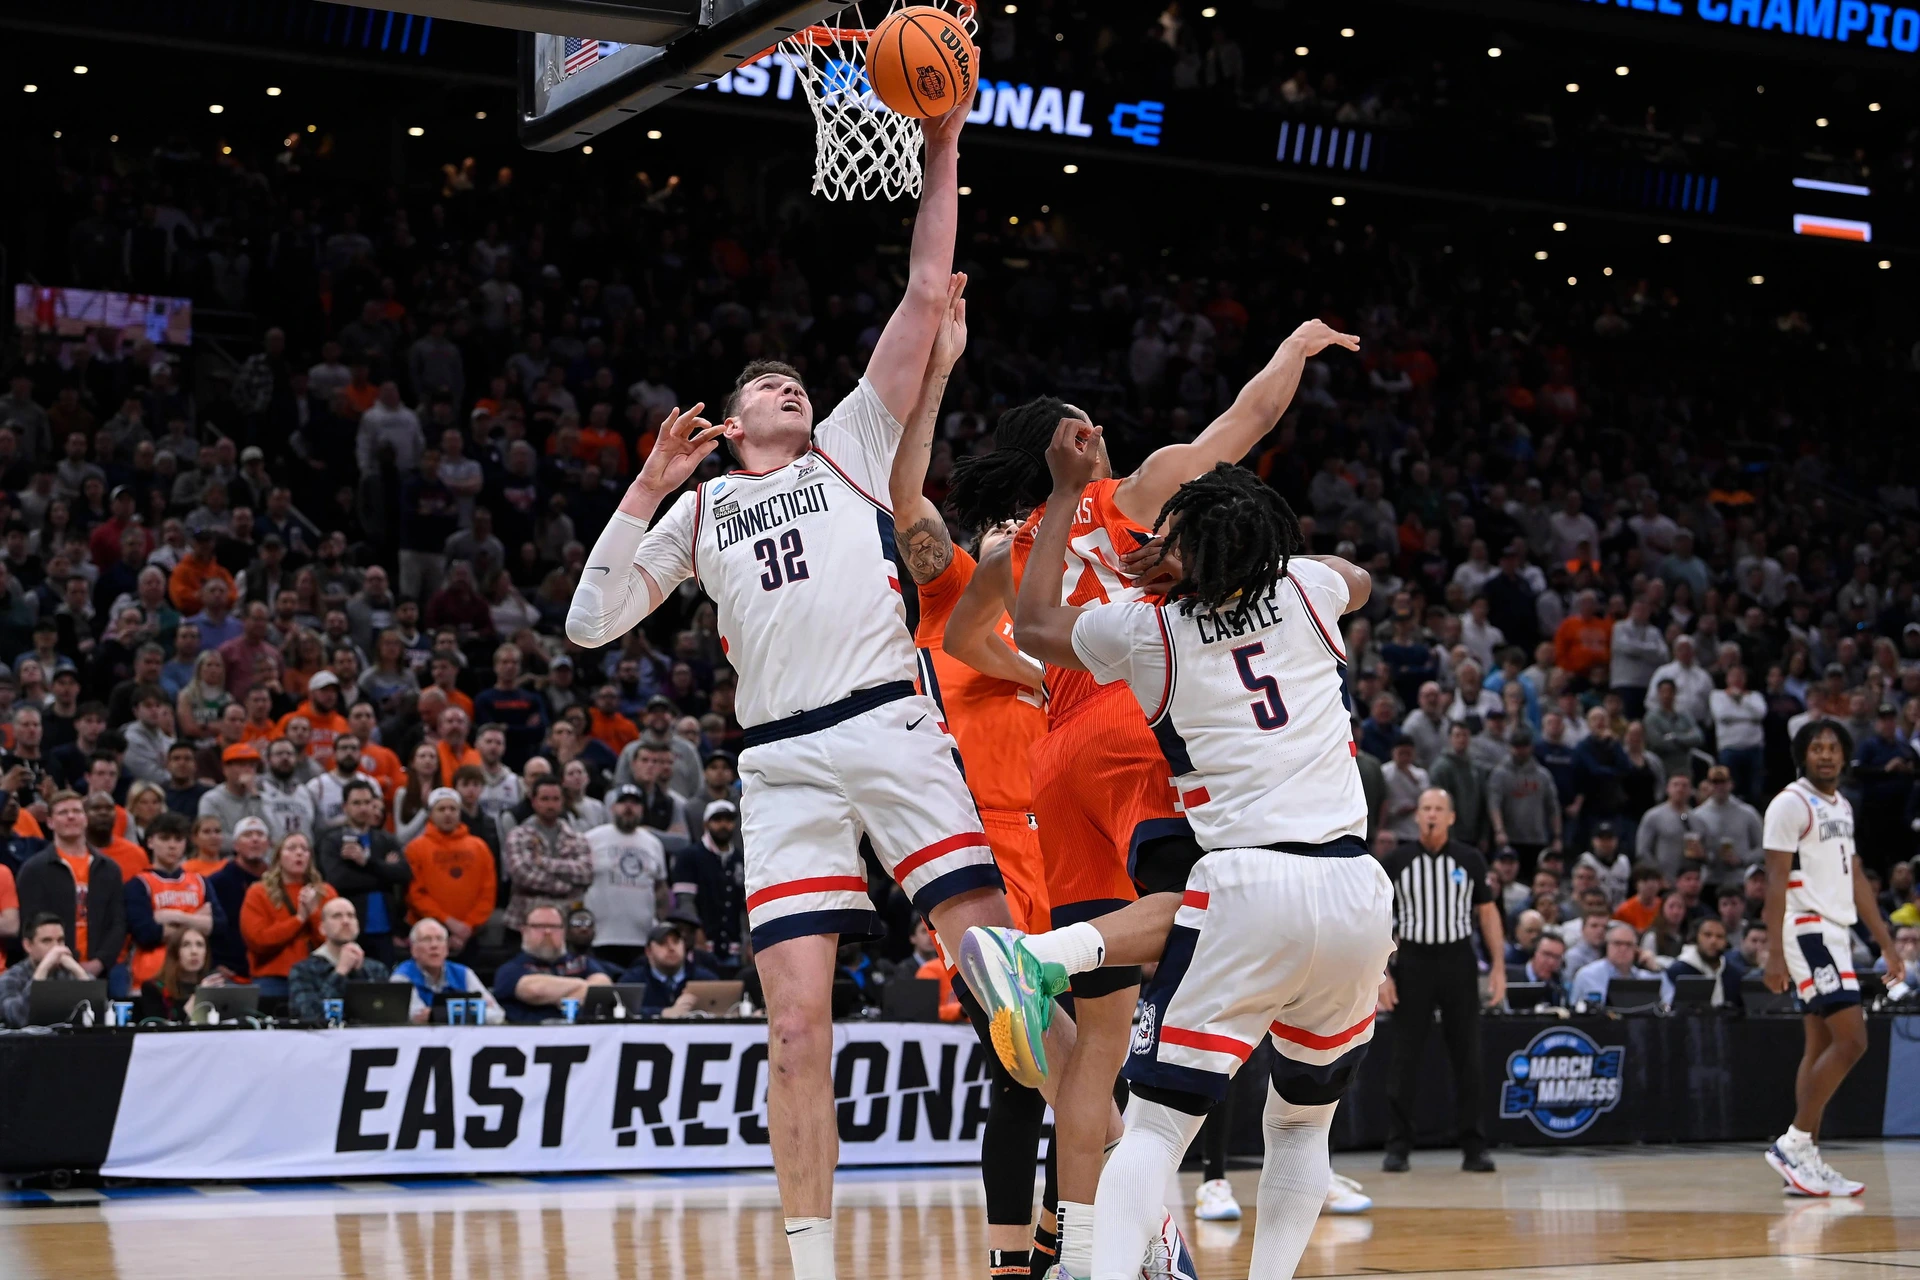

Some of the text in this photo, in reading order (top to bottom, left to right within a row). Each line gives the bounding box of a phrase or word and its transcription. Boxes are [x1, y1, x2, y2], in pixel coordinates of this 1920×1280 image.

[940, 26, 970, 97] Wilson
[715, 483, 829, 552] CONNECTICUT
[753, 528, 810, 592] 32
[1196, 597, 1283, 644] CASTLE
[1230, 641, 1289, 731] 5
[335, 1045, 590, 1153] EAST
[1528, 1055, 1593, 1080] MARCH
[1537, 1077, 1618, 1103] MADNESS
